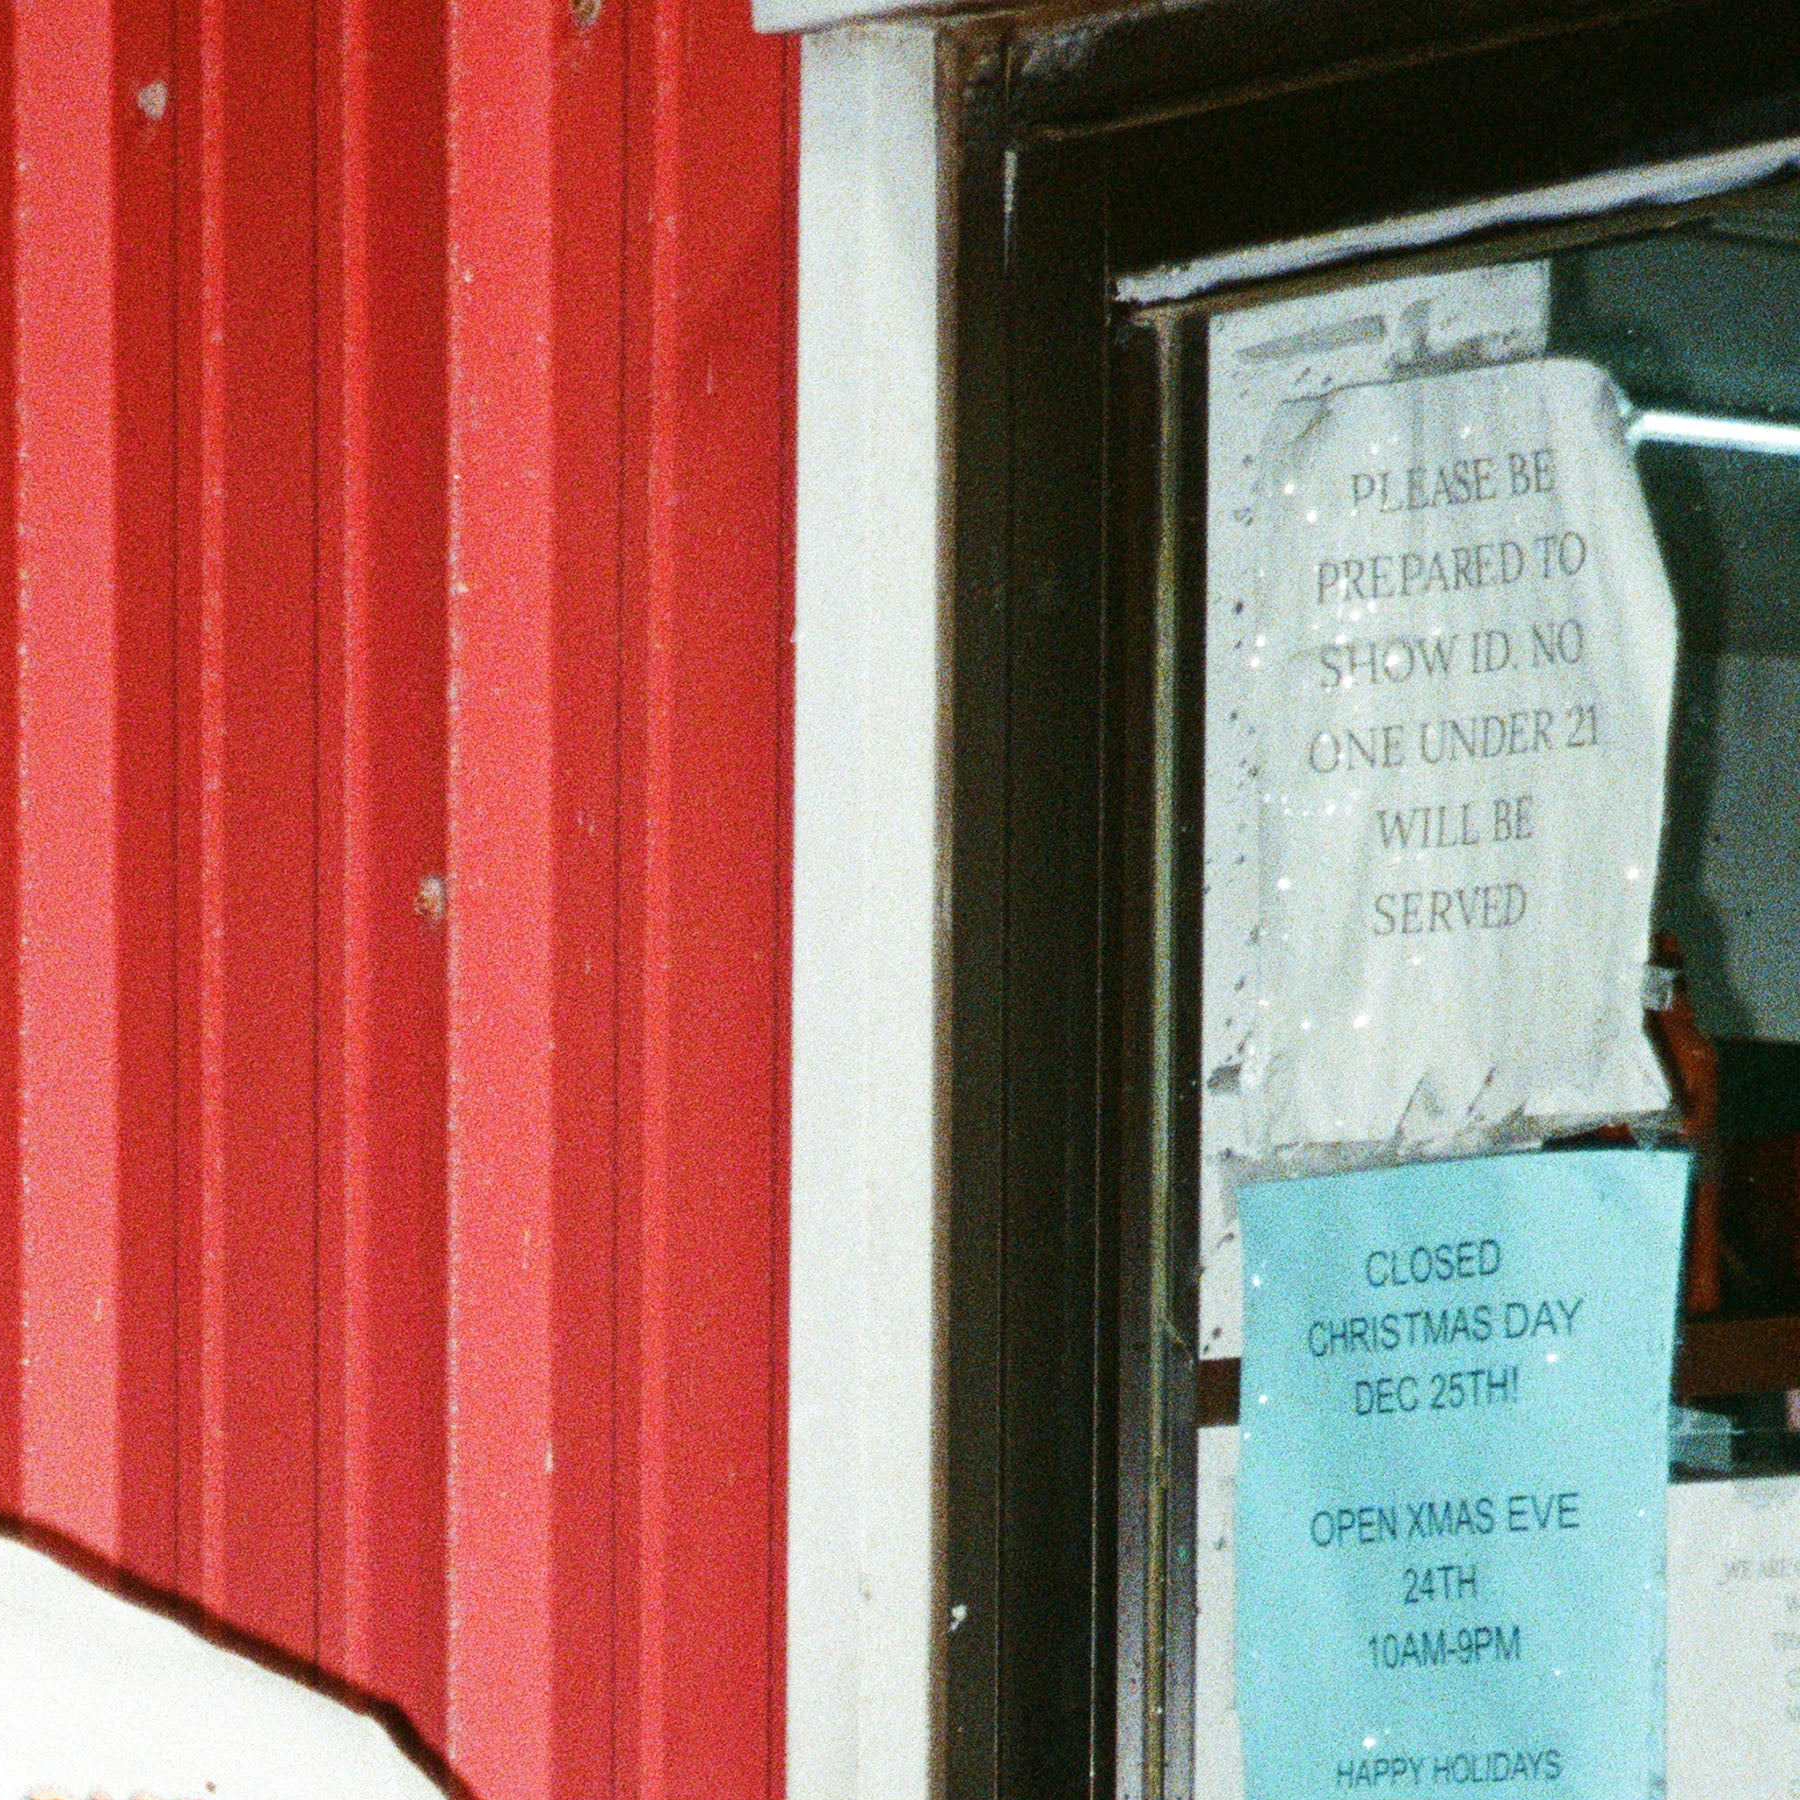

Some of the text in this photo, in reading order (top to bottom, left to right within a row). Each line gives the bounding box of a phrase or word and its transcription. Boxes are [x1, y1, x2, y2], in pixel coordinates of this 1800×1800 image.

[1350, 448, 1556, 513] PLEASE BE
[1316, 530, 1587, 605] PREPARED TO
[1320, 632, 1458, 692] SHOW
[1531, 617, 1585, 669] NO
[1309, 702, 1600, 775] ONE UNDER 21
[1377, 796, 1534, 850] WILL BE
[1373, 884, 1528, 937] SERVED
[1366, 1238, 1500, 1288] CLOSED
[1307, 1299, 1584, 1360] CHRISTMAS DAY
[1355, 1365, 1520, 1418] DEC 25TH!
[1310, 1491, 1581, 1549] OPEN XMAS EVE
[1403, 1564, 1478, 1605] 24TH
[1367, 1625, 1522, 1669] 10AM-9PM
[1336, 1748, 1564, 1790] HAPPY HOLIDAYS
